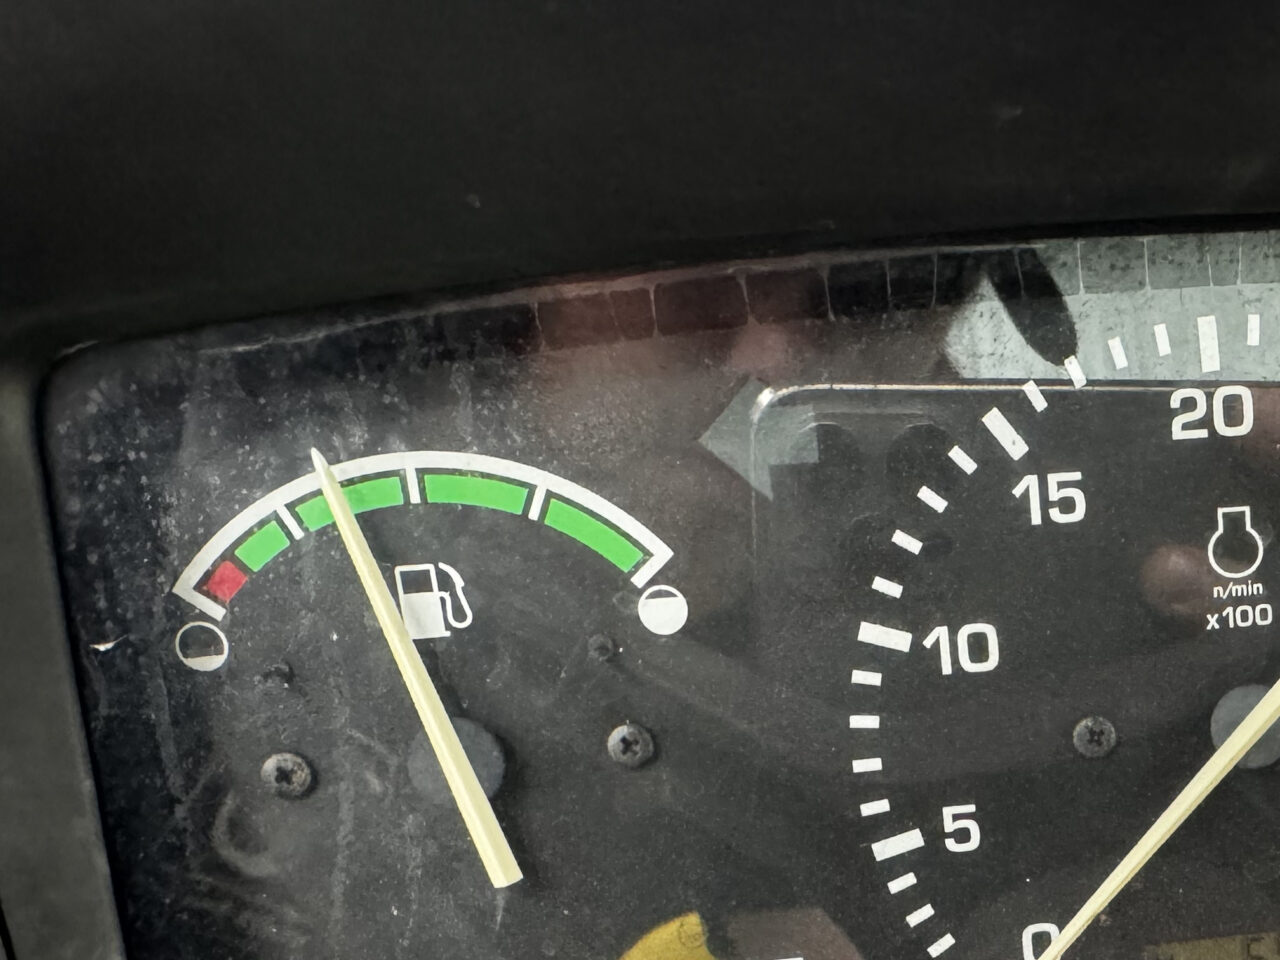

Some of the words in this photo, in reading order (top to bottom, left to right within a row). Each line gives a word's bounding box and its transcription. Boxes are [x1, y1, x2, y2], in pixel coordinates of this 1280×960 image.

[1169, 385, 1255, 441] 20
[1011, 471, 1087, 525] 15
[1213, 580, 1263, 599] n/min
[1206, 603, 1273, 630] x100
[922, 622, 1000, 676] 10
[942, 804, 981, 853] 5
